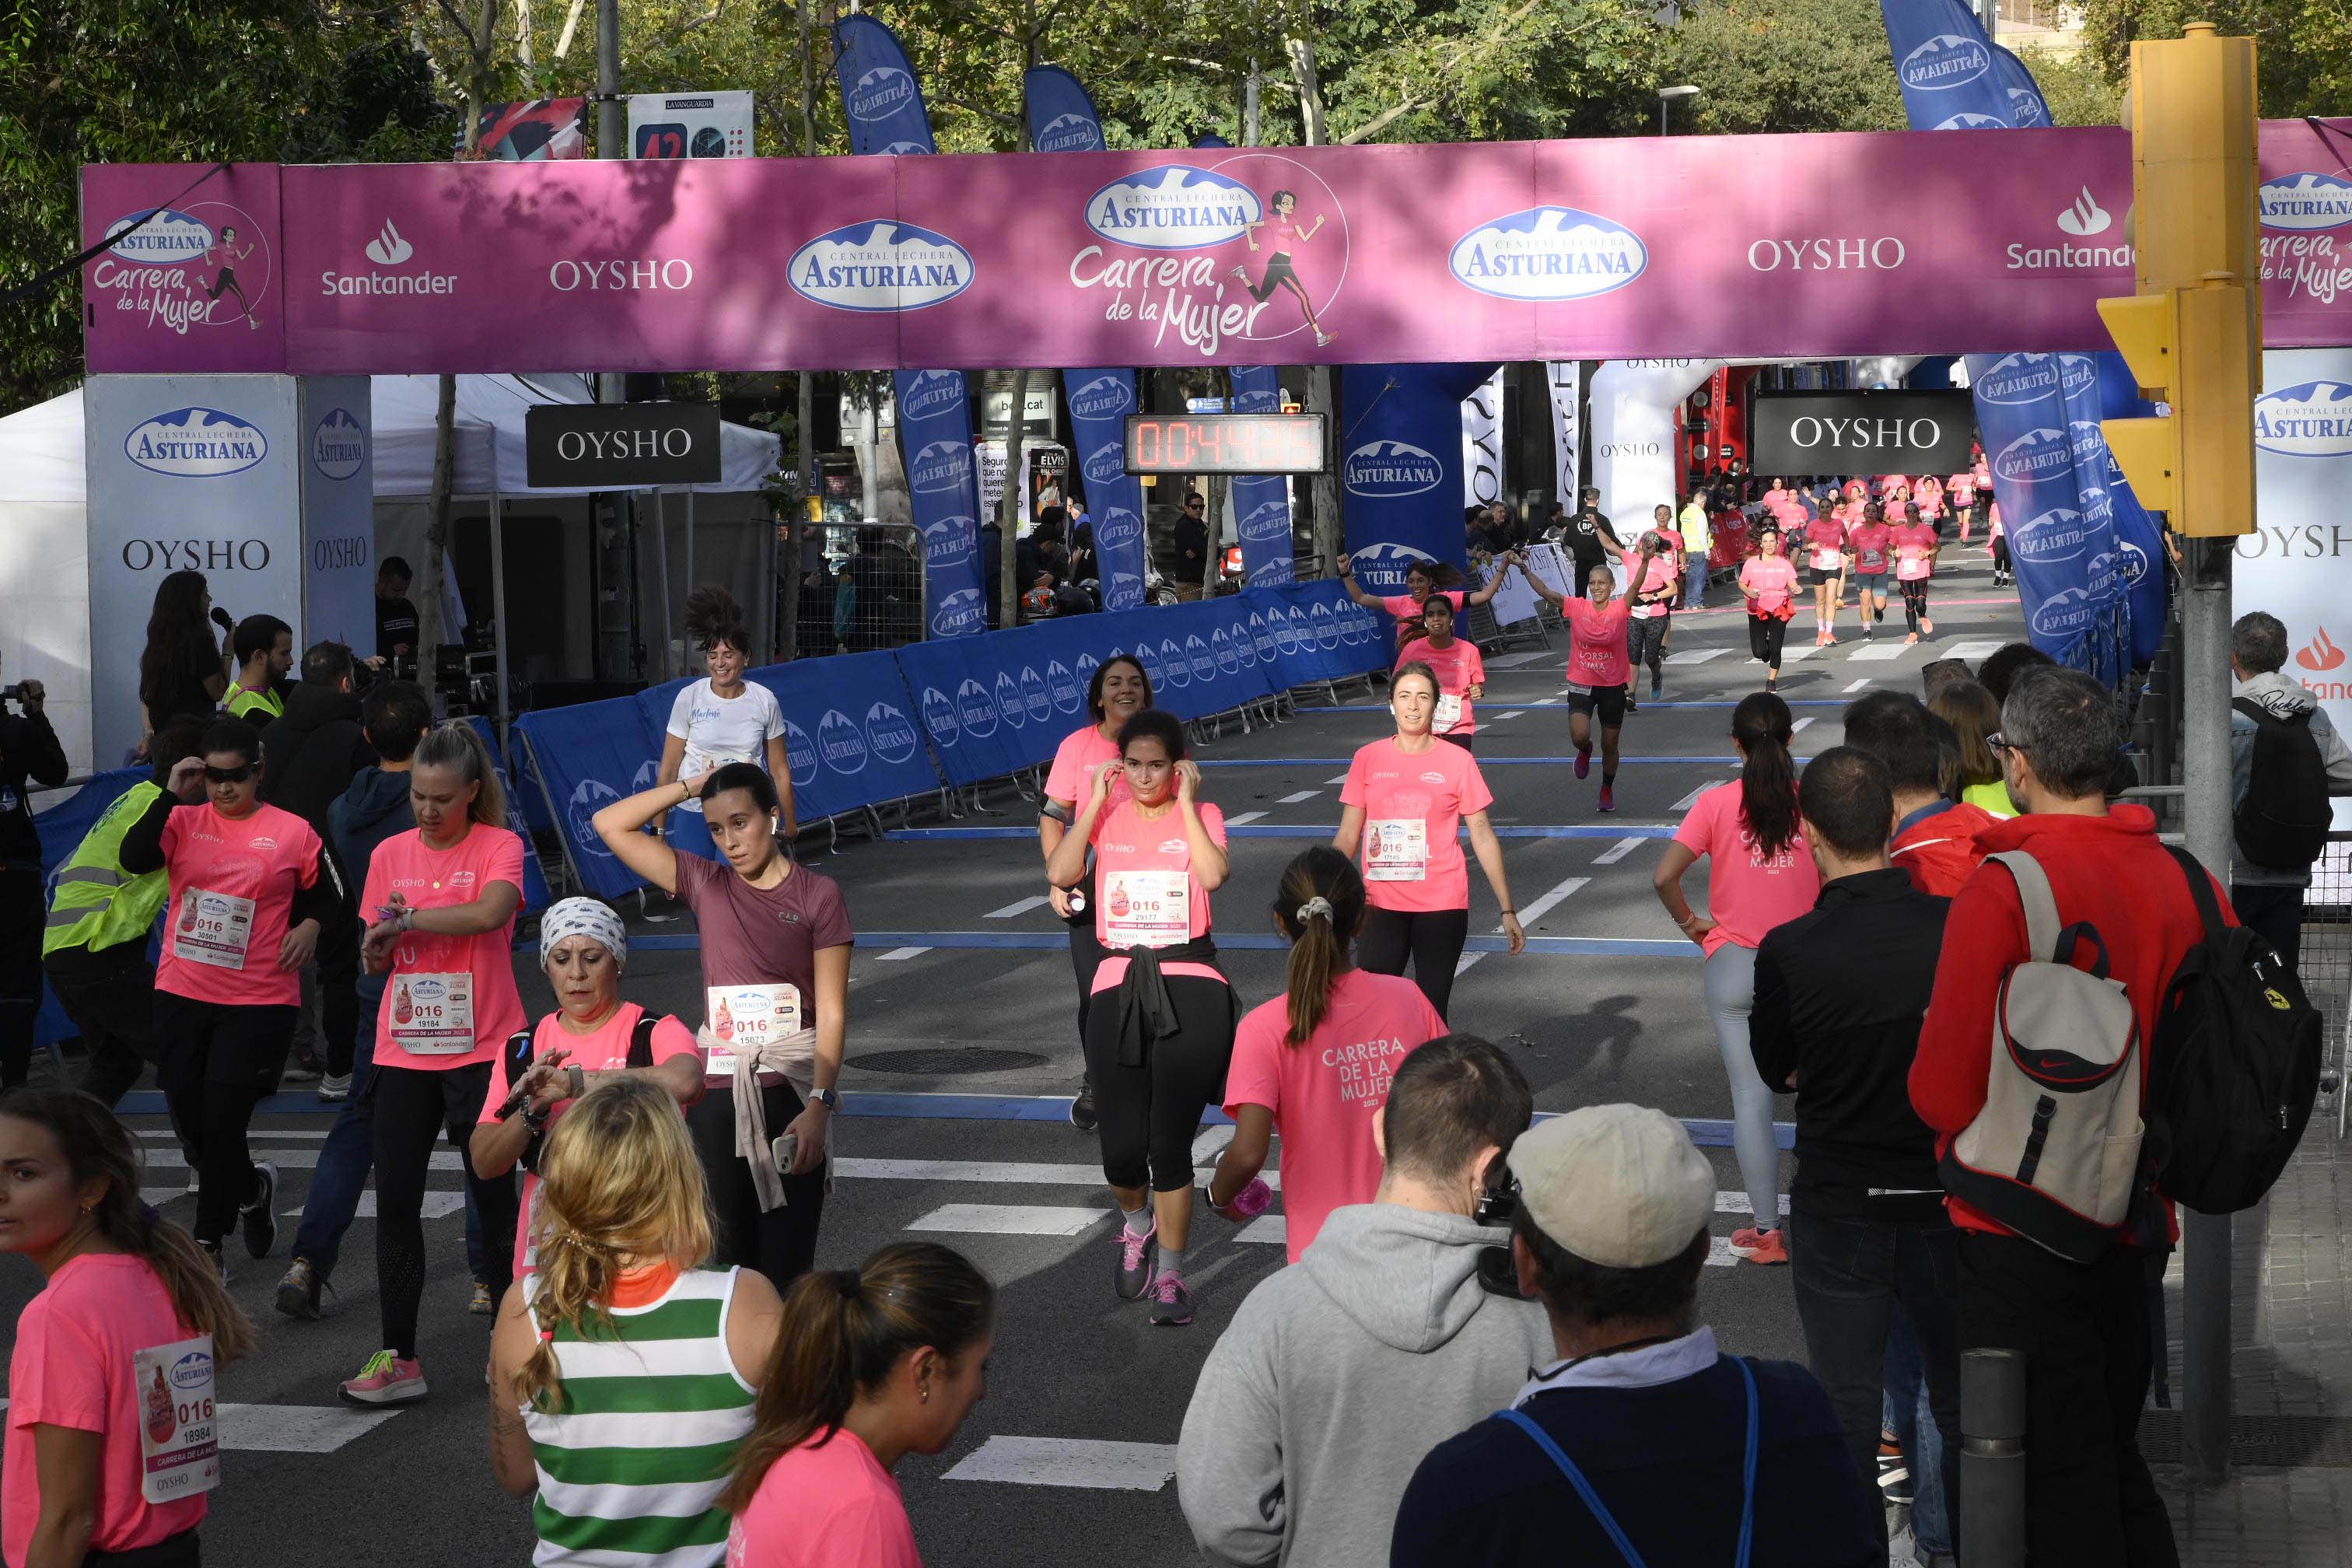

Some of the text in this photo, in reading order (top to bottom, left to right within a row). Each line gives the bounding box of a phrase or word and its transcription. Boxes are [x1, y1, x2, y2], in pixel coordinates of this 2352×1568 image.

[675, 99, 713, 108] VANGUARDIA
[1125, 192, 1244, 204] CENTRAL LECHERA
[1098, 197, 1248, 229] ASTURIANA
[830, 250, 954, 261] CENTRAL LECHERA
[1748, 236, 1906, 272] OYSHO
[2259, 235, 2333, 257] arrera
[1465, 243, 1632, 278] ASTURIANA
[2007, 242, 2136, 270] Santand
[94, 261, 186, 289] Carrera
[549, 258, 693, 292] OYSHO
[801, 254, 961, 289] ASTURIANA
[1069, 244, 1216, 289] Carrera
[321, 271, 458, 296] Santander
[2278, 258, 2292, 280] la
[2289, 256, 2352, 304] Muje
[117, 285, 221, 334] de la Mujer
[1105, 282, 1270, 356] de la Mujer
[1001, 399, 1044, 411] b.cat
[1790, 416, 1941, 450] OYSHO
[135, 434, 258, 460] ASTURIANA
[317, 436, 362, 462] ASTURIANA
[556, 427, 692, 461] OYSHO
[1600, 442, 1660, 459] OYSHO
[1041, 456, 1065, 466] ELVIS
[1347, 464, 1436, 485] ASTURIANA
[1582, 522, 1593, 530] BP
[122, 539, 271, 571] OYSHO
[313, 537, 367, 571] OYSHO
[786, 747, 815, 769] TURIANA
[825, 737, 865, 760] ASTURIANA
[191, 831, 225, 845] OYSHO
[1104, 842, 1135, 853] OYSHO
[1382, 843, 1402, 852] 016
[392, 878, 425, 888] OYSHO
[1132, 901, 1160, 911] 016
[197, 919, 223, 933] 016
[198, 931, 217, 941] 30501
[213, 954, 239, 963] Santander
[413, 987, 444, 996] ASTURIANA
[415, 1006, 443, 1017] 016
[733, 999, 768, 1010] ASTURIANA
[737, 1019, 768, 1033] 016
[740, 1036, 765, 1045] 15073
[1322, 1035, 1405, 1067] CARRERA
[716, 1059, 736, 1069] OYSH
[1339, 1058, 1391, 1083] DE LA
[1362, 1098, 1379, 1108] 2023
[178, 1398, 212, 1424] 016
[184, 1426, 211, 1444] 18984
[157, 1454, 187, 1467] CARRERA
[187, 1451, 196, 1459] DE
[157, 1473, 188, 1491] OYSHO
